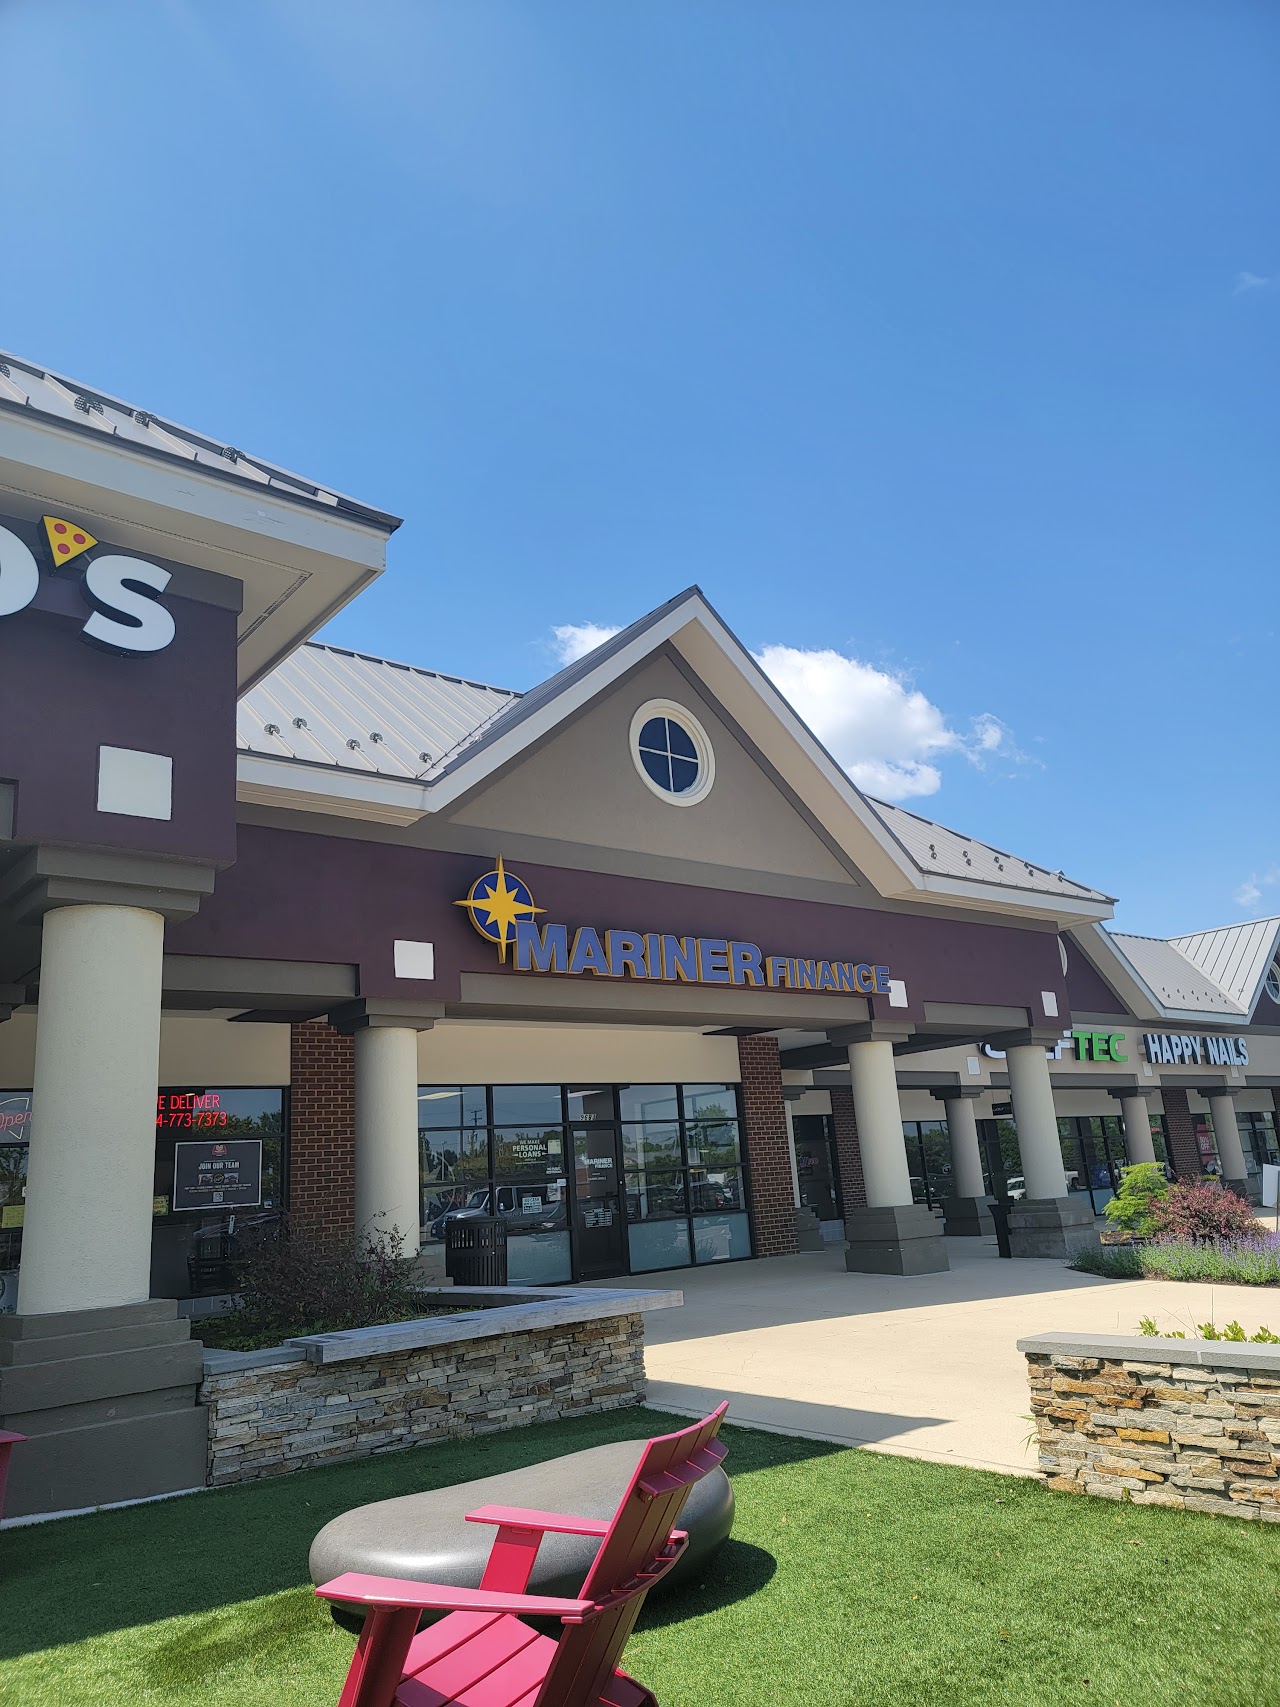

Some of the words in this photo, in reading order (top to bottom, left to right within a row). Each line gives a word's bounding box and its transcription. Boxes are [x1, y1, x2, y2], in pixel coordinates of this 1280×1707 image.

[514, 919, 765, 986] MARINER
[766, 955, 892, 993] FINANCE
[1143, 1034, 1201, 1064] HAPPY
[1202, 1036, 1249, 1066] NAILS
[157, 1095, 166, 1110] E
[170, 1094, 220, 1109] DELIVER
[225, 1161, 240, 1169] TEAM
